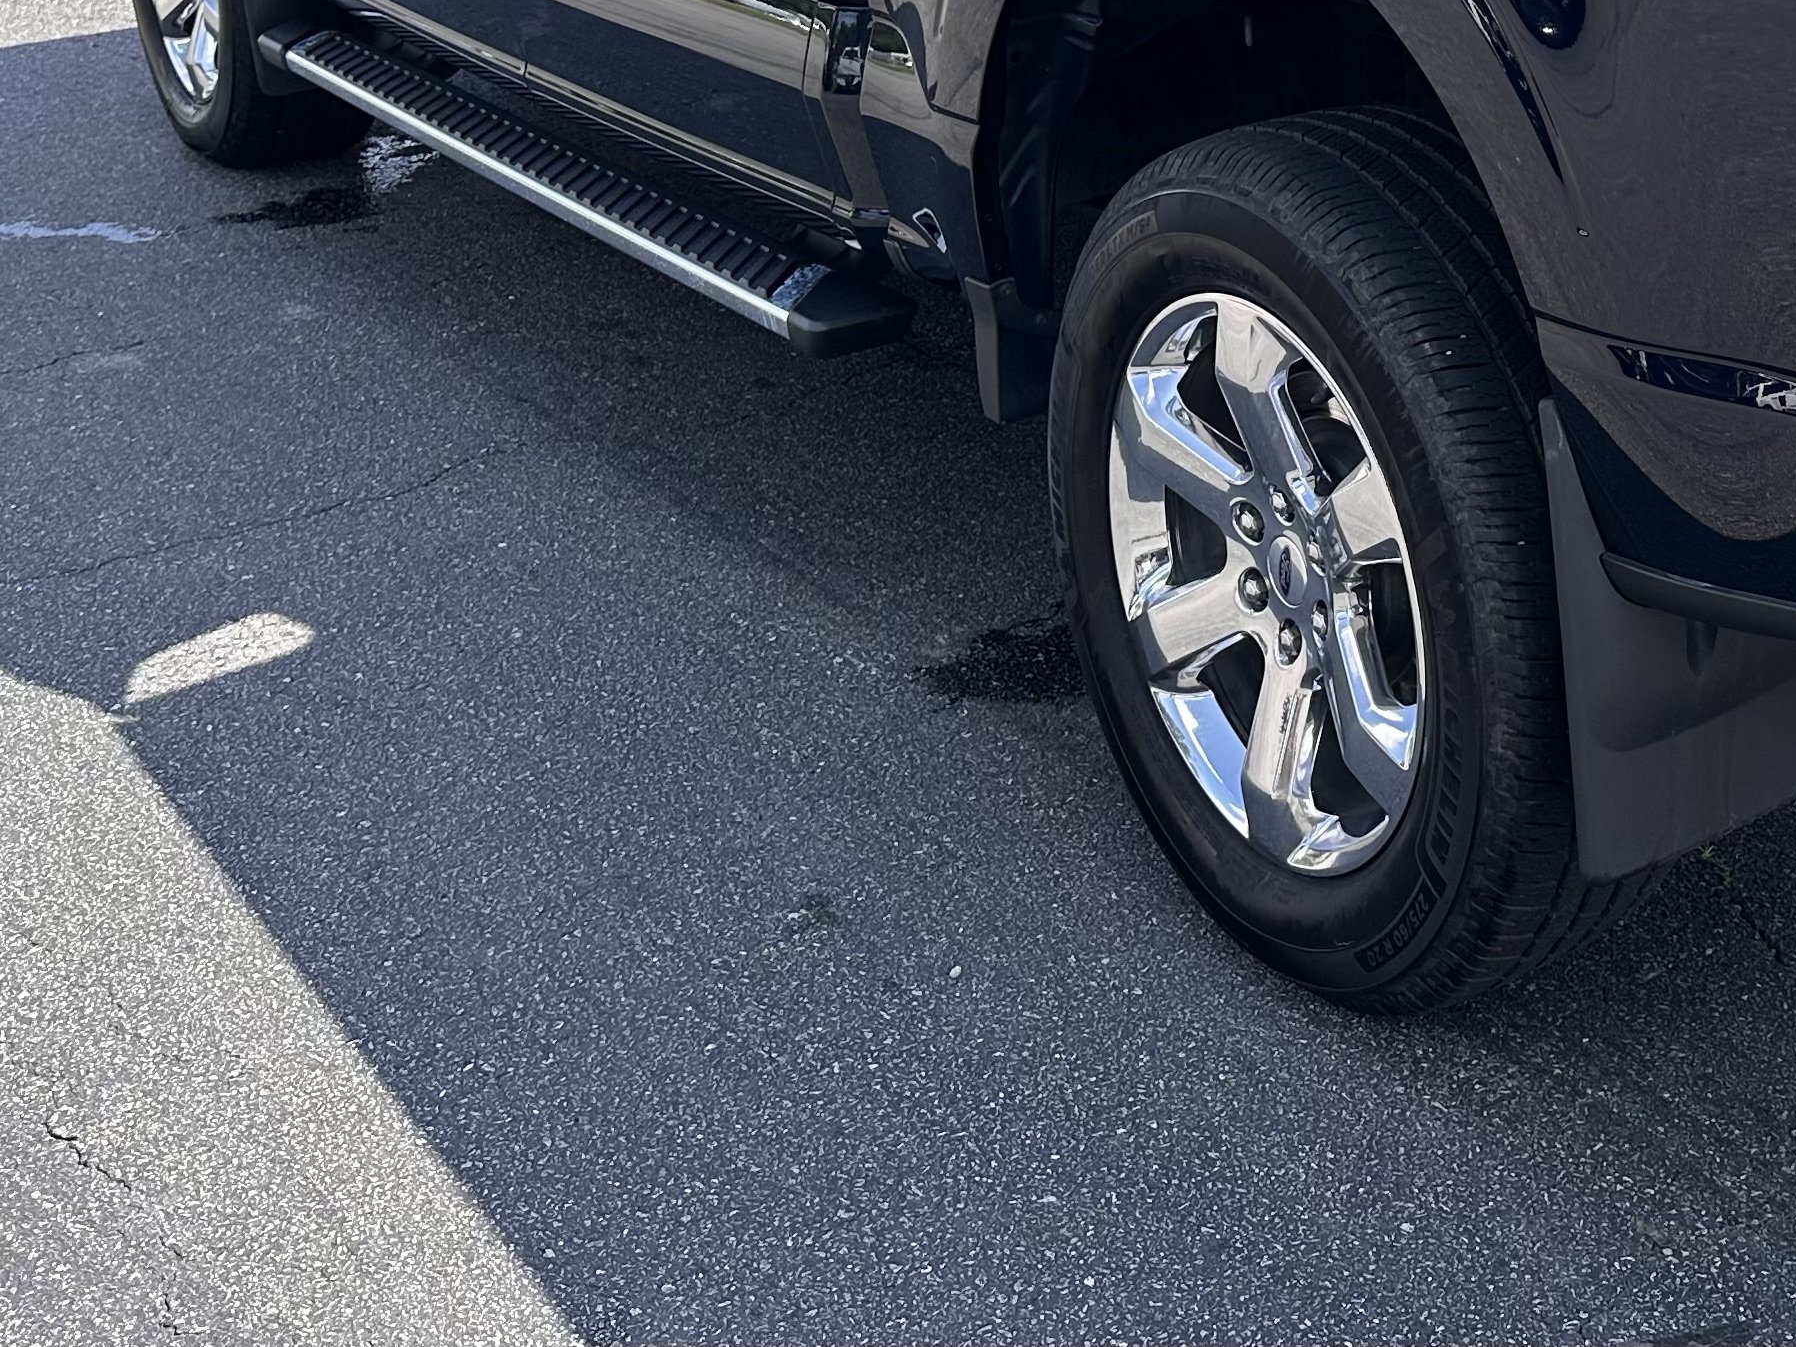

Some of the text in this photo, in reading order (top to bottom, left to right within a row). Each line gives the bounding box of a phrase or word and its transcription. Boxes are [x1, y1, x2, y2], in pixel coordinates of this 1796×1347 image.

[1367, 893, 1429, 966] 275/60 R 20
